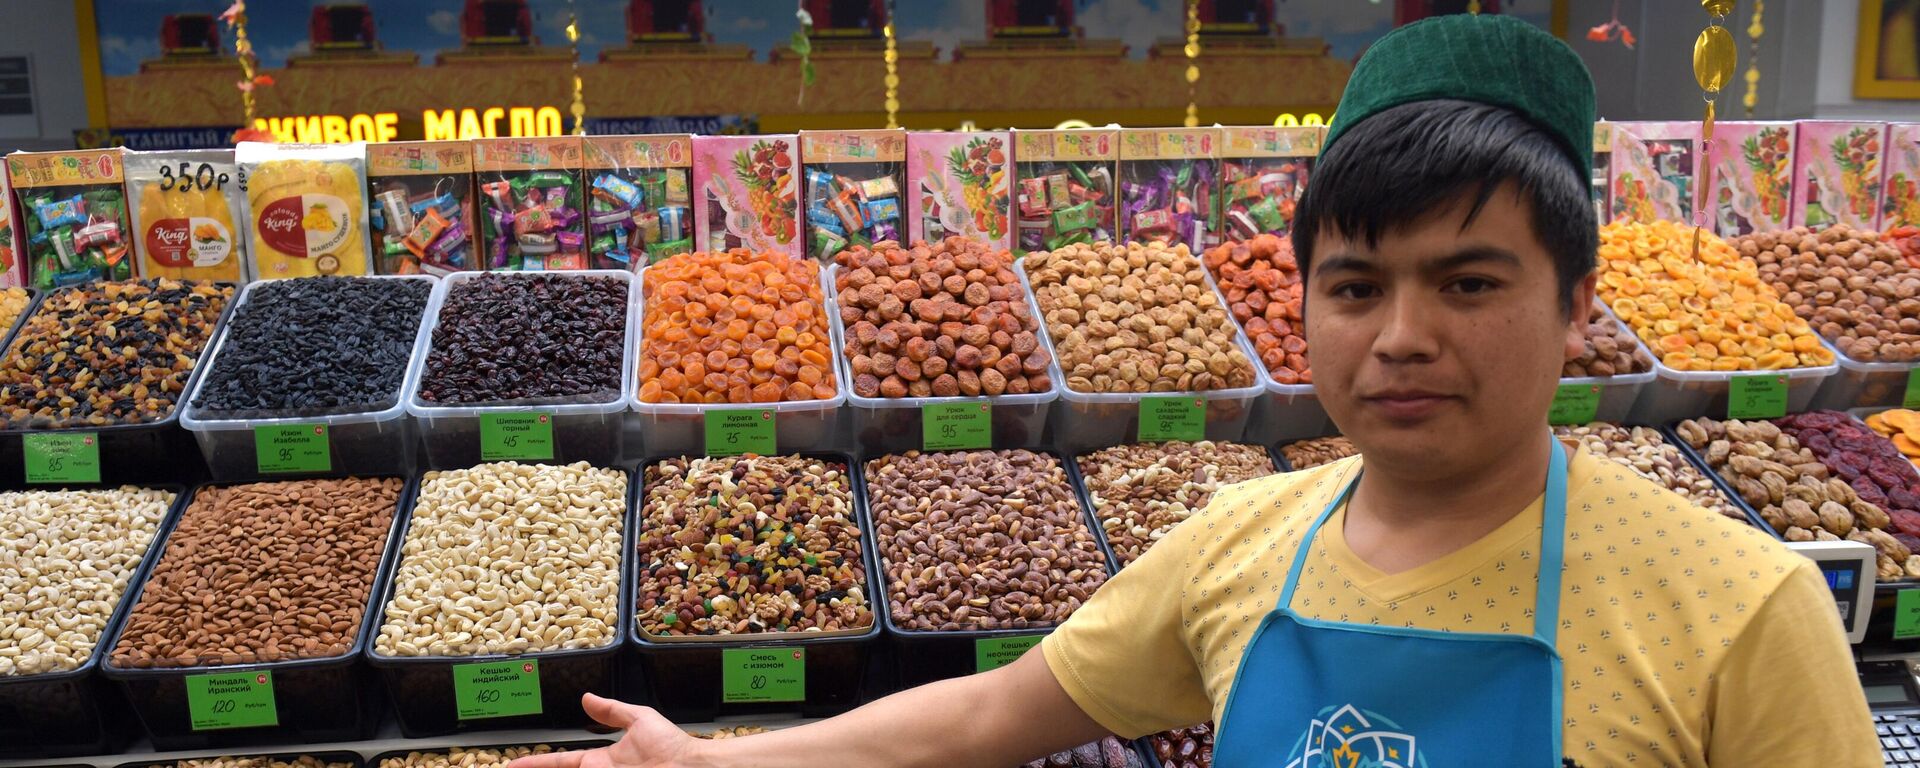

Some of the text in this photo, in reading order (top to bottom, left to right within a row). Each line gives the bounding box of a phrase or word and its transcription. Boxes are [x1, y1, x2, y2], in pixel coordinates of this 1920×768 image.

[264, 217, 297, 232] King
[155, 227, 188, 245] King
[942, 424, 958, 438] 95
[503, 435, 520, 448] 45
[280, 448, 294, 461] 95
[48, 457, 64, 472] 85
[480, 667, 511, 675] Кешью
[209, 678, 249, 686] Миндаль
[473, 673, 520, 684] индийский
[751, 675, 767, 689] 80
[208, 685, 252, 694] Иранский
[475, 689, 500, 703] 160
[211, 699, 236, 713] 120
